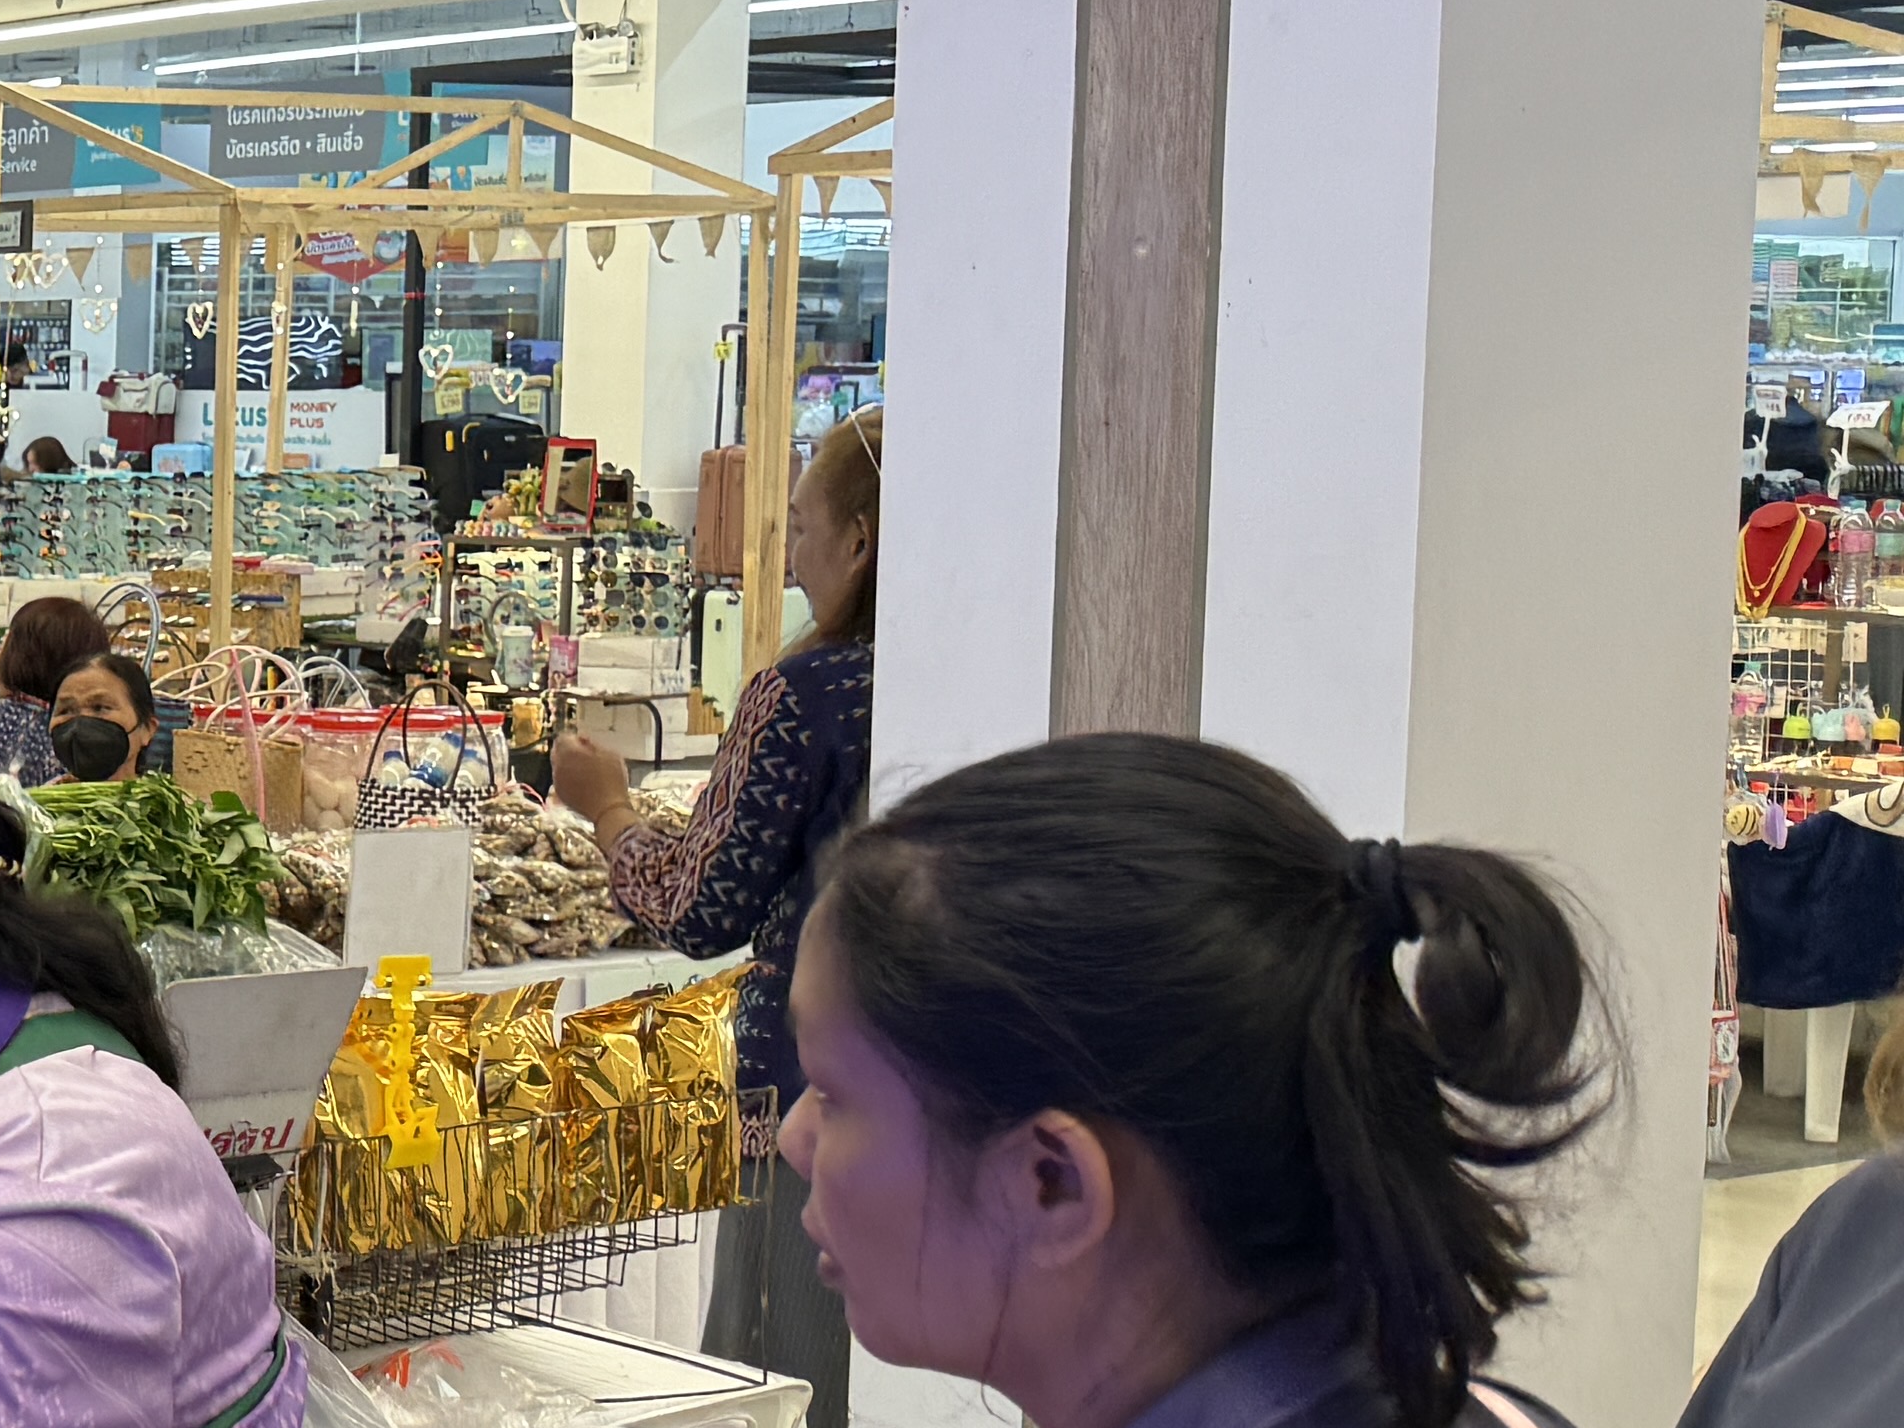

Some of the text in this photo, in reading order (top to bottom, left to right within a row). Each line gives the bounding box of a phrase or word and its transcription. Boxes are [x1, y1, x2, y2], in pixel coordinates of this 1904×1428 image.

[226, 124, 364, 159] บัตรเครดิต สินเชื่อ
[202, 402, 268, 428] Lus
[290, 402, 338, 413] MONEY
[289, 417, 325, 429] PLUS
